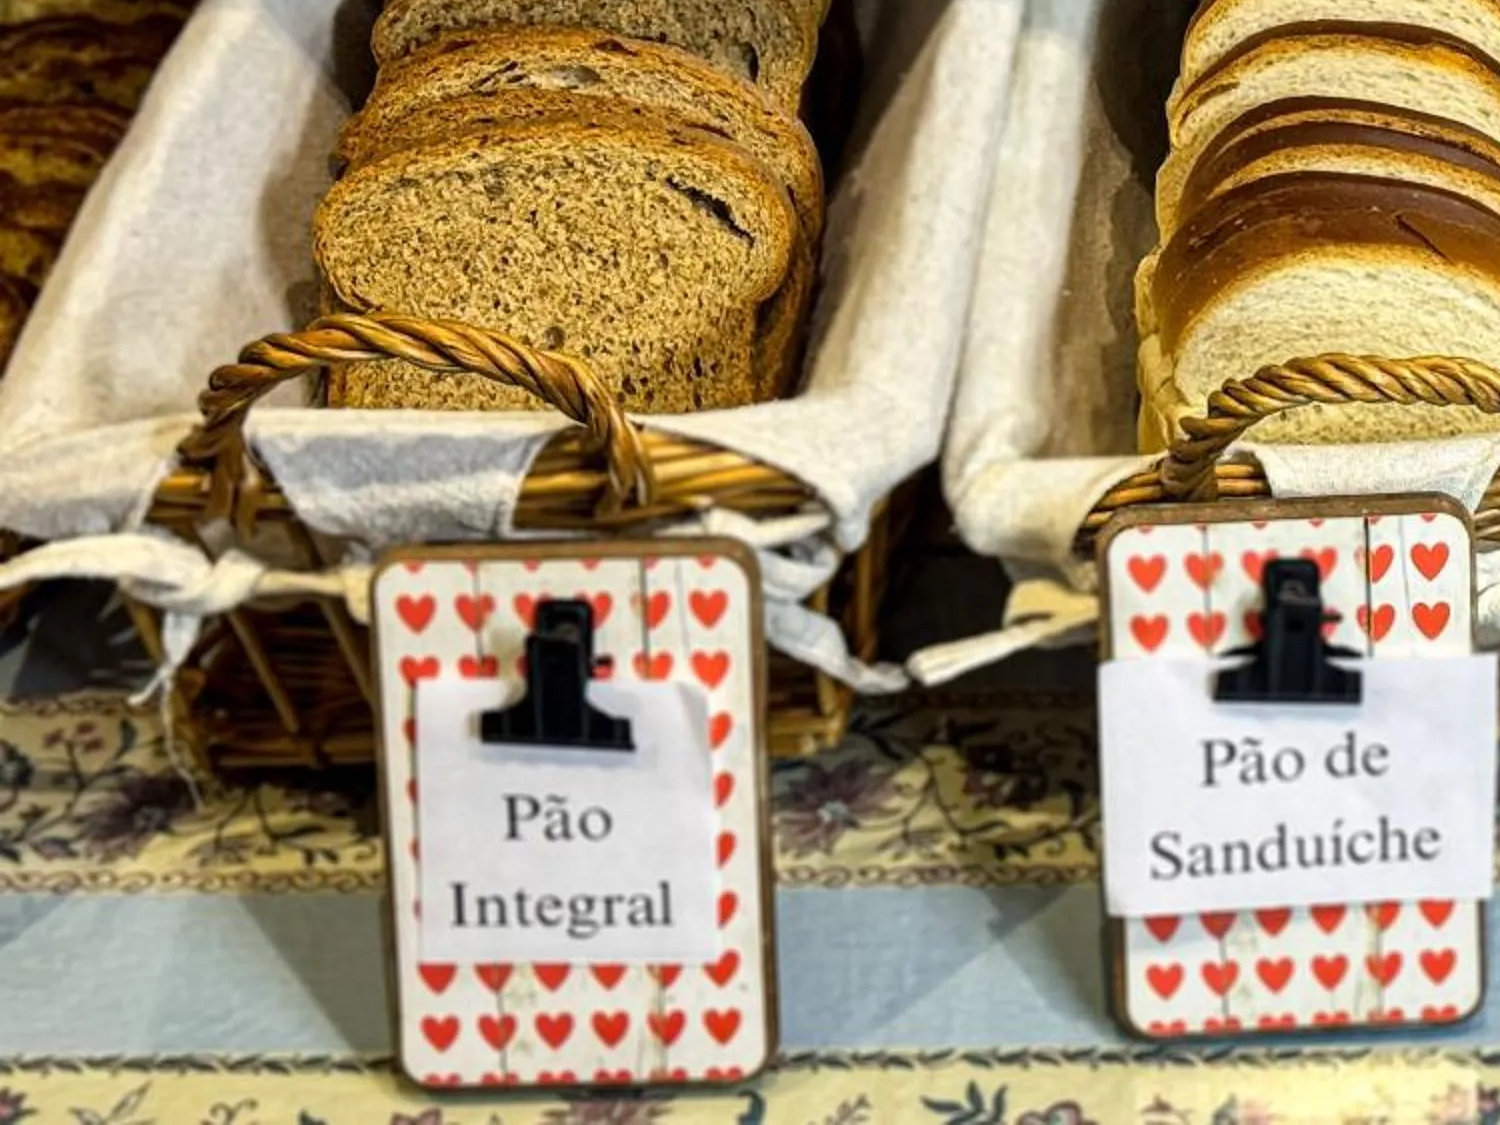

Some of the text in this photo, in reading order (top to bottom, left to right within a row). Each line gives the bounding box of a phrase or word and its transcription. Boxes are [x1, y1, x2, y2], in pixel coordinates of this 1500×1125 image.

[1200, 731, 1389, 786] Pão de
[502, 793, 613, 843] Pão
[1149, 815, 1442, 881] Sanduíche
[450, 880, 675, 940] Integral
